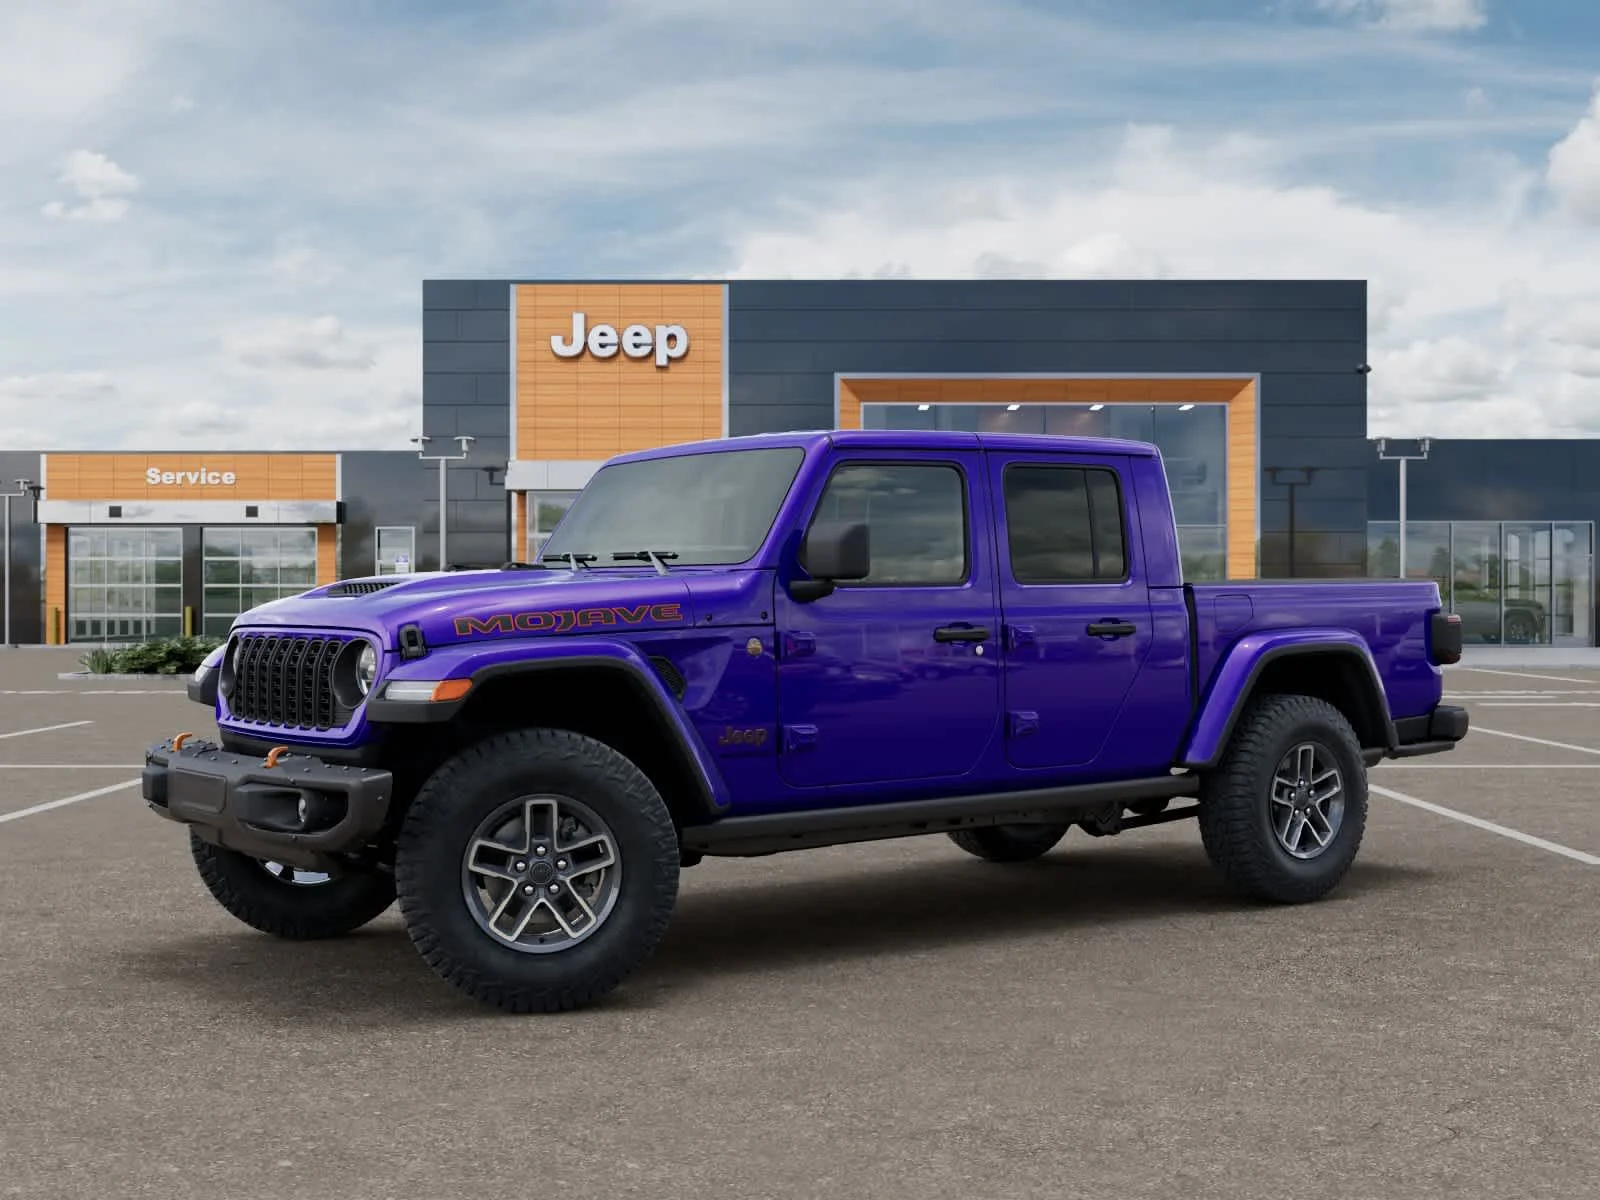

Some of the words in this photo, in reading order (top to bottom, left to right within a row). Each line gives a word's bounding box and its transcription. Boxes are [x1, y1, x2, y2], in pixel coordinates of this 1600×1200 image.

[550, 311, 689, 367] Jeep
[146, 466, 236, 486] Service
[454, 604, 682, 635] MOJAVE
[719, 725, 767, 747] Jeep
